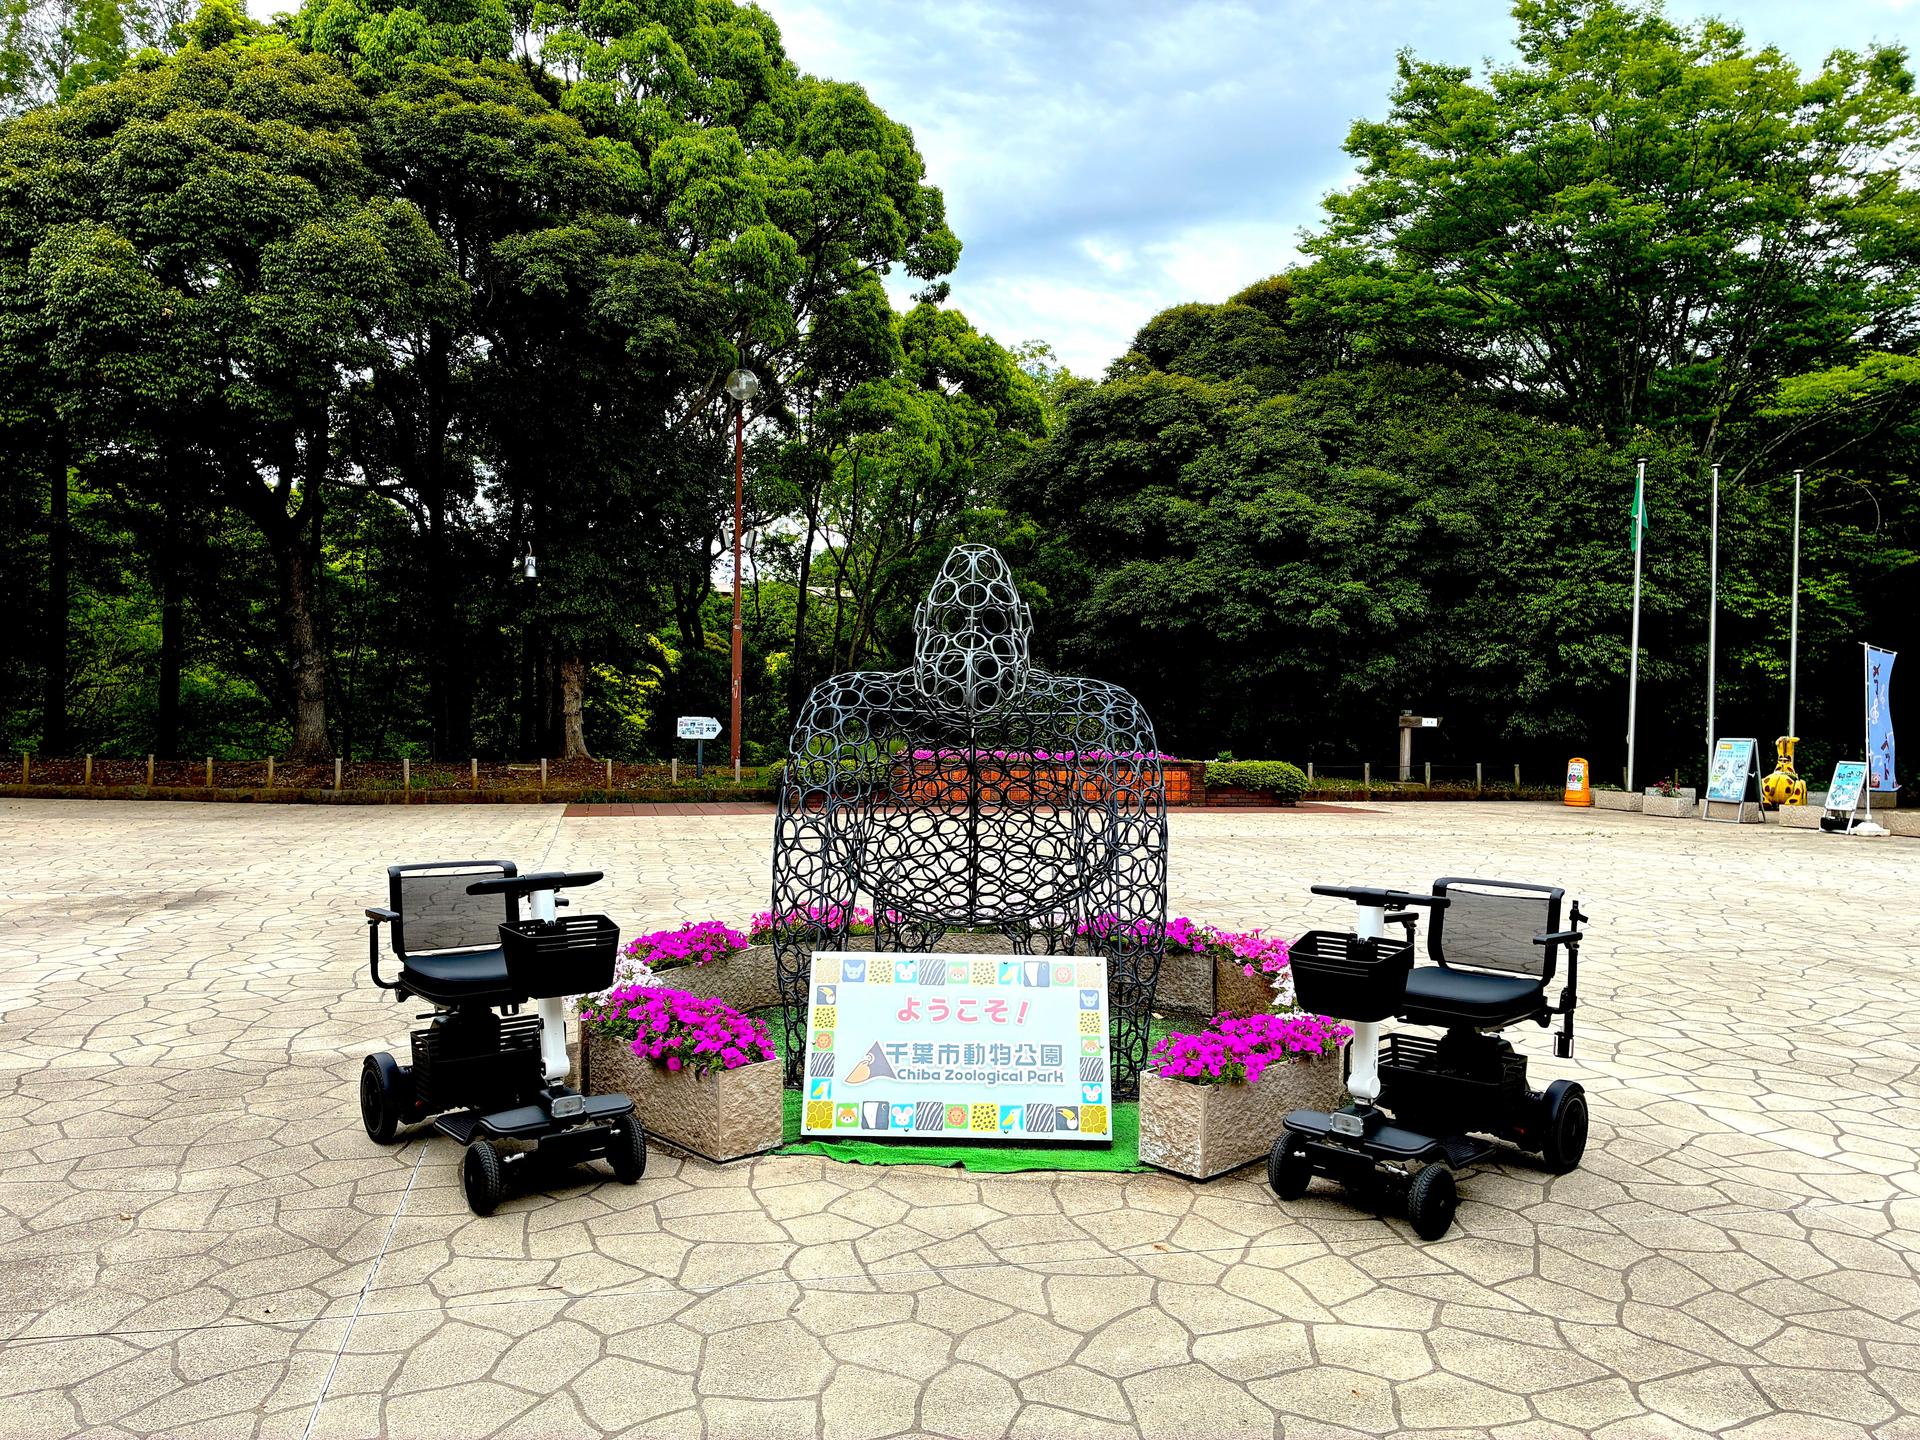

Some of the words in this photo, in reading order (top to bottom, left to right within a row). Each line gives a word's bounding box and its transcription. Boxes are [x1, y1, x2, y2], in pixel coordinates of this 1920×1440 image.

[897, 996, 1029, 1024] ようこそ！
[885, 1042, 1063, 1067] 千葉市動物公園
[897, 1068, 941, 1081] Chiba
[944, 1069, 1023, 1085] Zoological
[1027, 1070, 1064, 1083] Park
